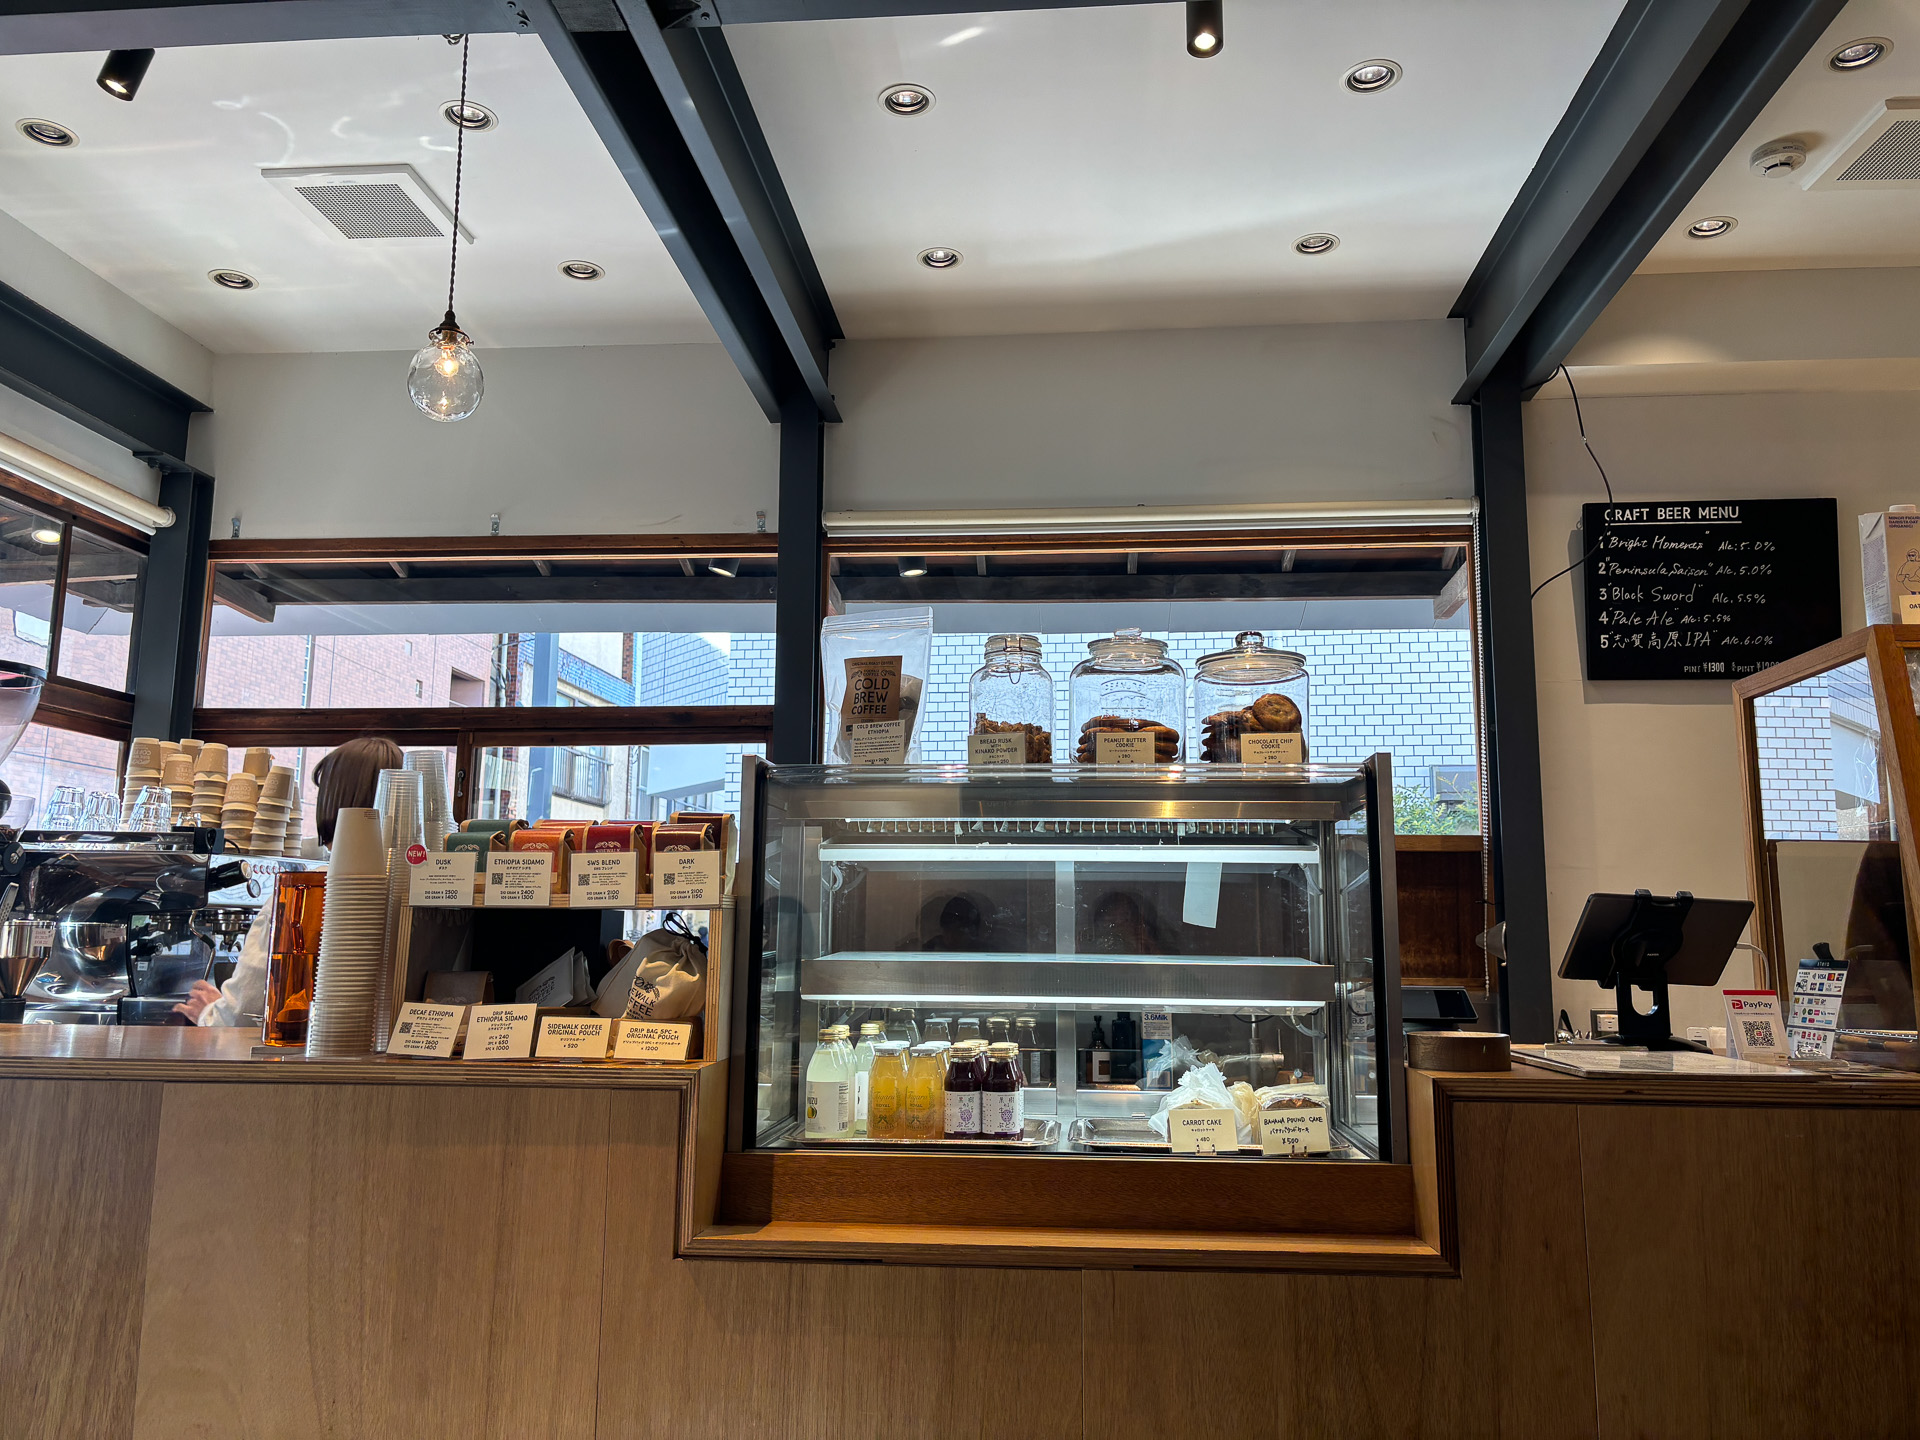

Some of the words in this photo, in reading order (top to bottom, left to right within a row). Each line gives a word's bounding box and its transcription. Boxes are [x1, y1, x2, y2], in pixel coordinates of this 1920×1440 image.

[1604, 508, 1650, 521] CRAFT
[1657, 507, 1691, 520] BEER
[1698, 505, 1739, 519] MENU
[1598, 562, 1606, 574] 2
[1739, 563, 1773, 575] 5.0%
[1599, 588, 1607, 600] 3
[1737, 593, 1766, 604] 5.5%
[1598, 611, 1608, 624] 4
[1703, 614, 1731, 623] 5.5%
[1600, 635, 1608, 648] 5
[1744, 635, 1774, 645] 6.0%
[1703, 662, 1725, 673] ¥1300
[854, 677, 890, 691] COLD
[854, 691, 889, 705] BREW
[851, 704, 887, 715] COFFEE
[407, 849, 426, 858] NEW!
[1743, 1001, 1773, 1009] PayPay
[409, 1008, 427, 1016] DECAF
[428, 1009, 454, 1018] ETHIOPIA
[505, 1014, 528, 1022] SIDAMO
[1144, 1013, 1168, 1021] 3.6Milk
[1286, 1116, 1306, 1124] POUND
